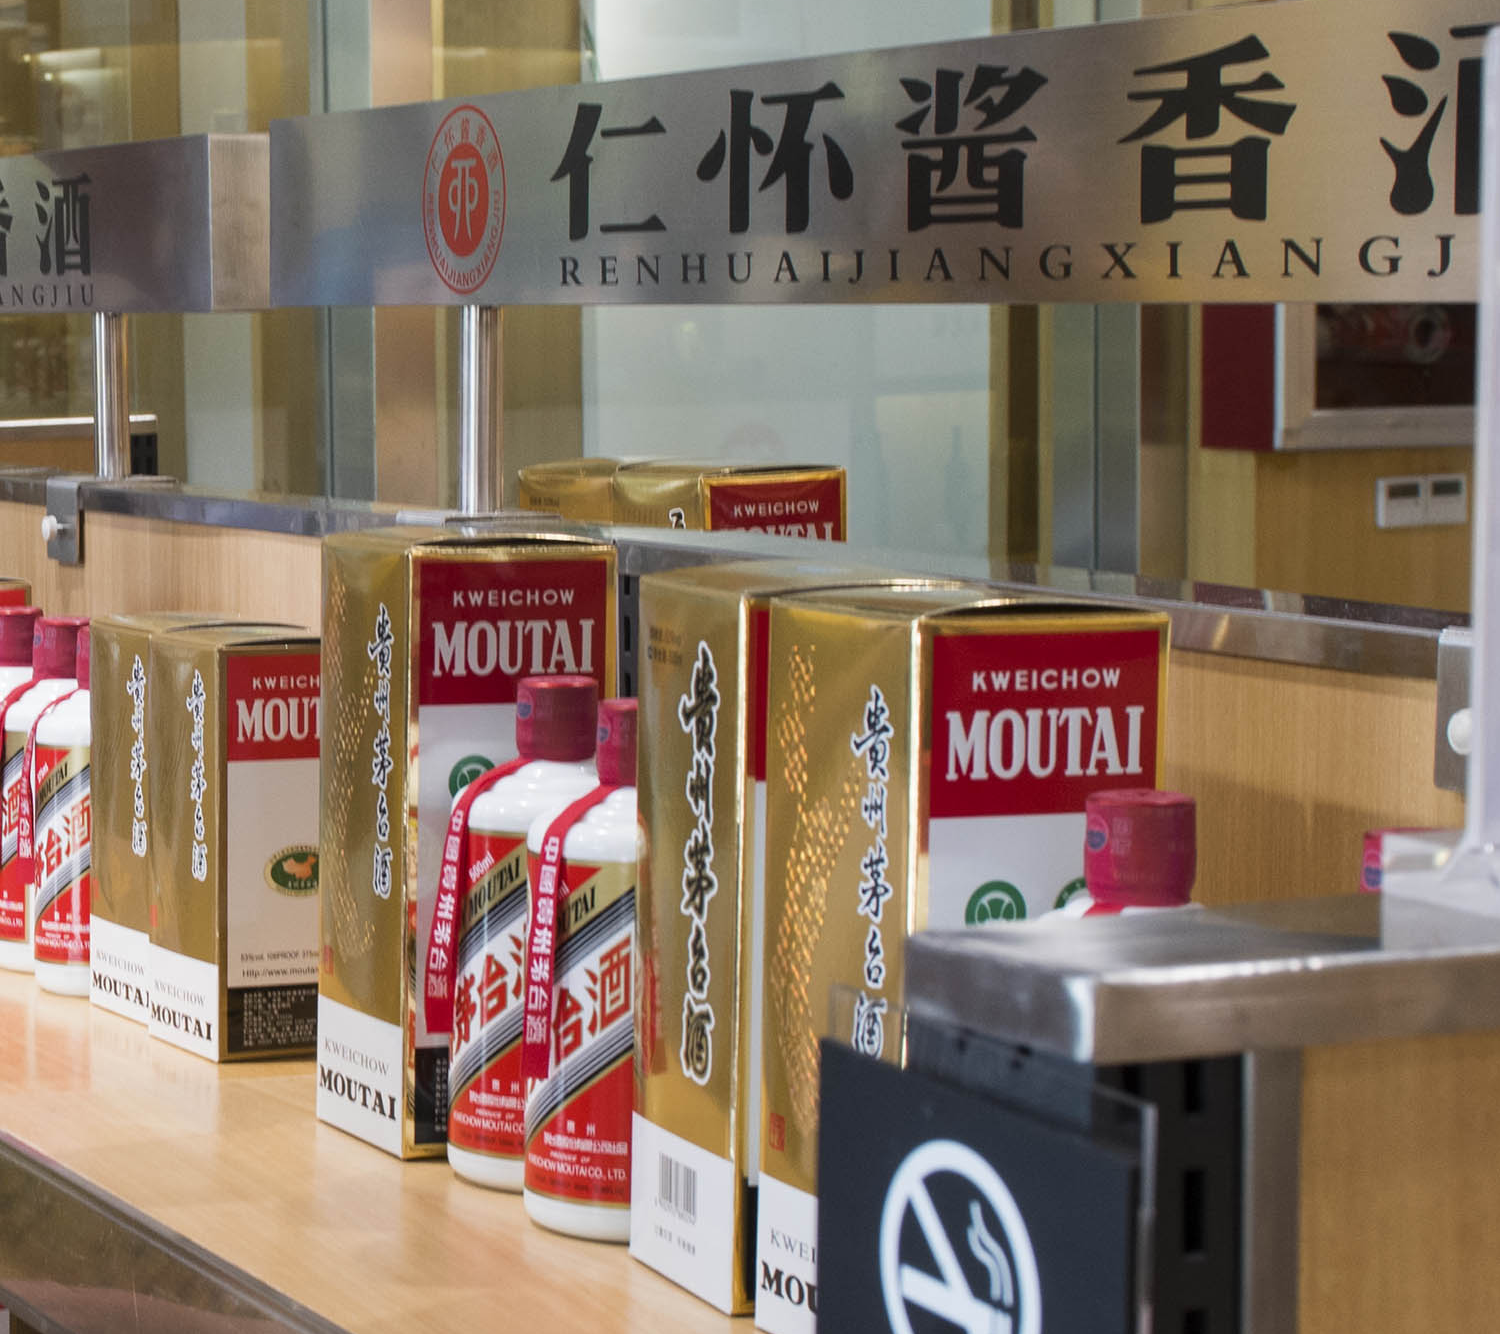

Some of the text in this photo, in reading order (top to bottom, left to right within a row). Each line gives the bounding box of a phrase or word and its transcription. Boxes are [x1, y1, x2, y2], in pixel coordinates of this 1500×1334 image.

[733, 500, 820, 518] KWEICHOW
[452, 589, 575, 608] KWEICHOW
[431, 618, 596, 678] MOUTAI
[972, 668, 1121, 693] KWEICHOW
[945, 705, 1145, 782] MOUTAI
[468, 856, 522, 924] MOUTAI
[150, 1000, 213, 1042] MOUTAI
[324, 1036, 390, 1077] KWEICHOW
[319, 1064, 397, 1121] MOUTAI
